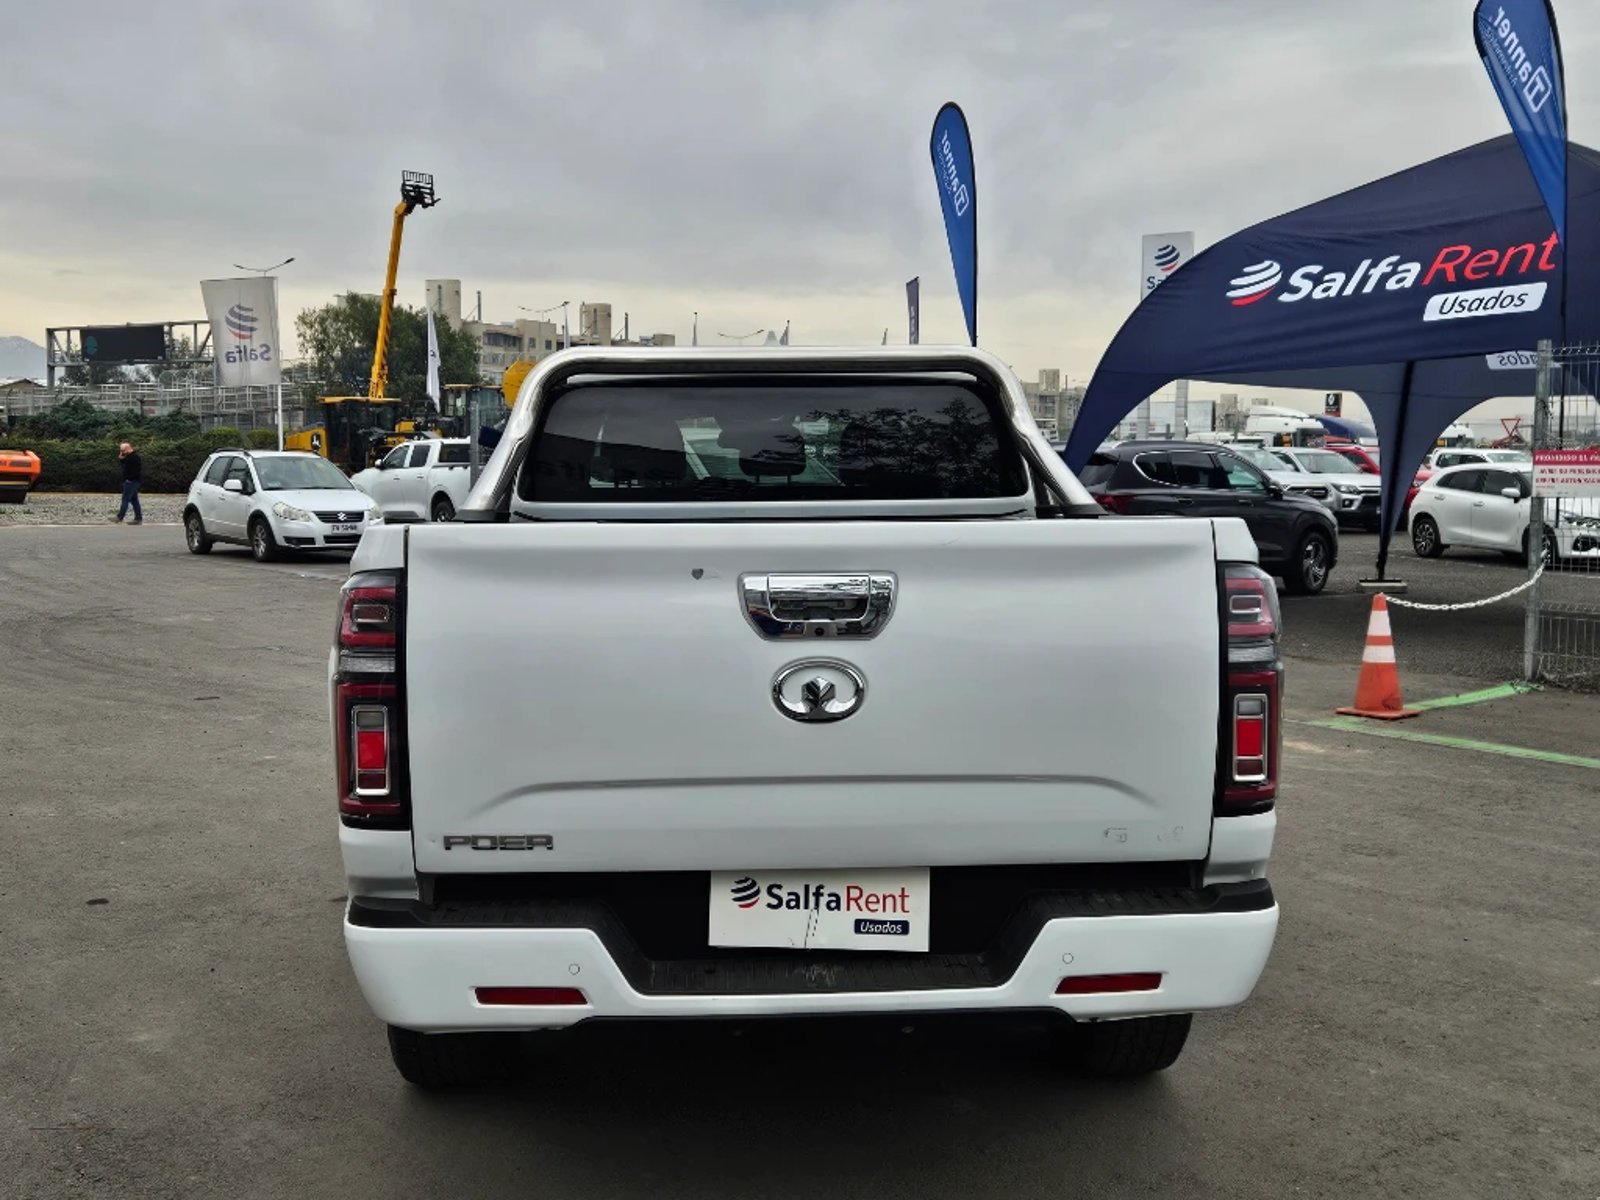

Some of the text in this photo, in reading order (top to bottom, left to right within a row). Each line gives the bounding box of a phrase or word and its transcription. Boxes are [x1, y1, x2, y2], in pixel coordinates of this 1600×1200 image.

[1438, 289, 1528, 315] Usados
[443, 835, 553, 851] POER
[766, 883, 910, 913] SalfaRent
[860, 921, 903, 934] Usados
